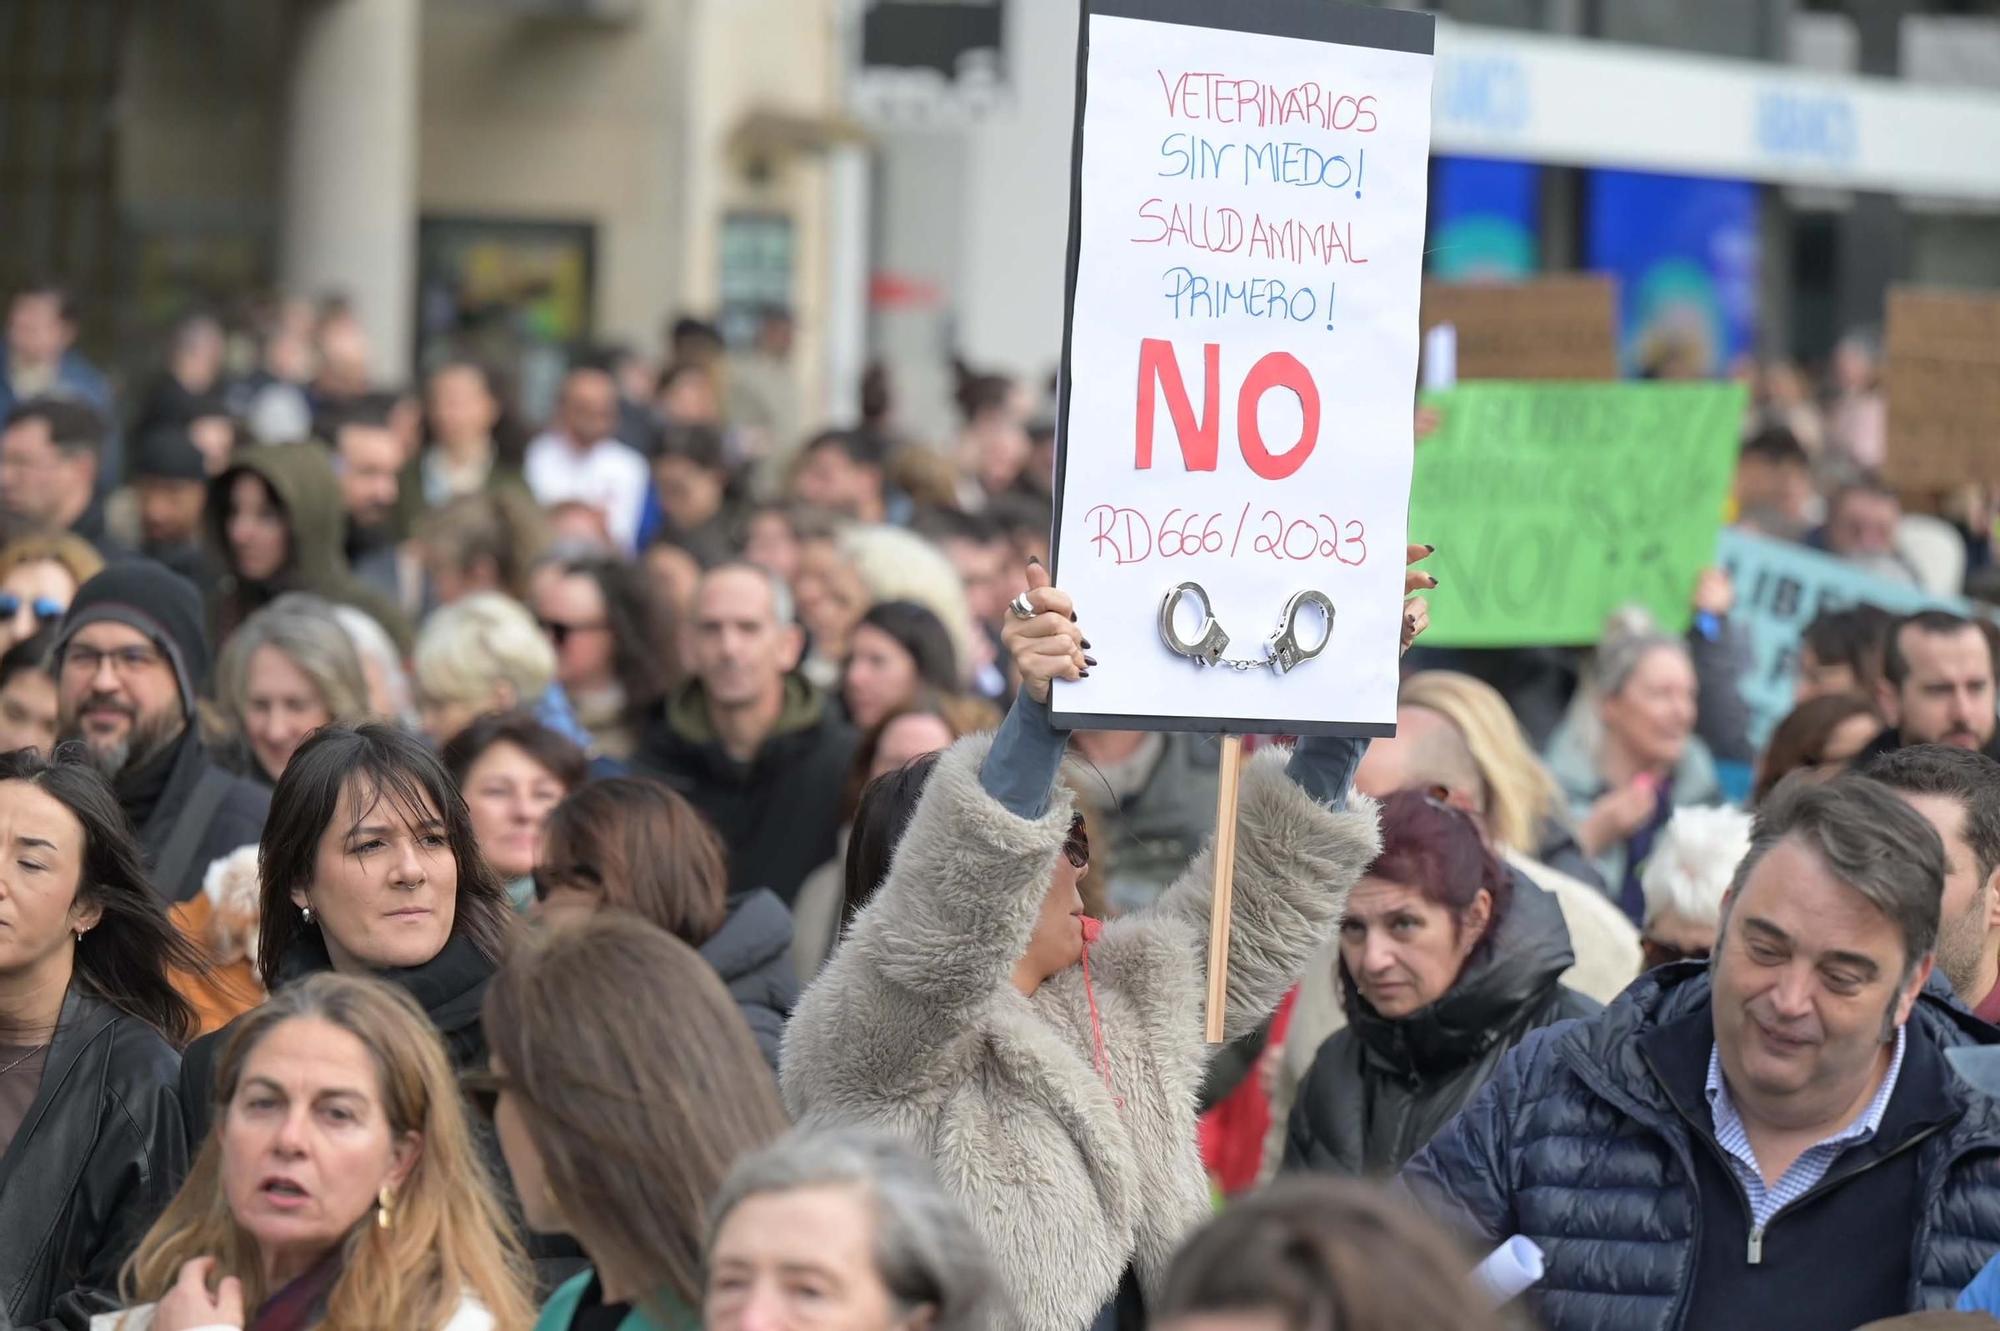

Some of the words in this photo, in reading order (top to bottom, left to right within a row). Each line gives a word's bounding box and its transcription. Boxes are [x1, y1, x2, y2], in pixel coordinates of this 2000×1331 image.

[1157, 69, 1378, 132] VETERINARIOS
[1158, 133, 1236, 180] SIN
[1245, 141, 1364, 200] MIEDO!
[1130, 197, 1244, 254] SALUD
[1162, 266, 1336, 331] PRIMERO!
[1134, 337, 1321, 481] NO
